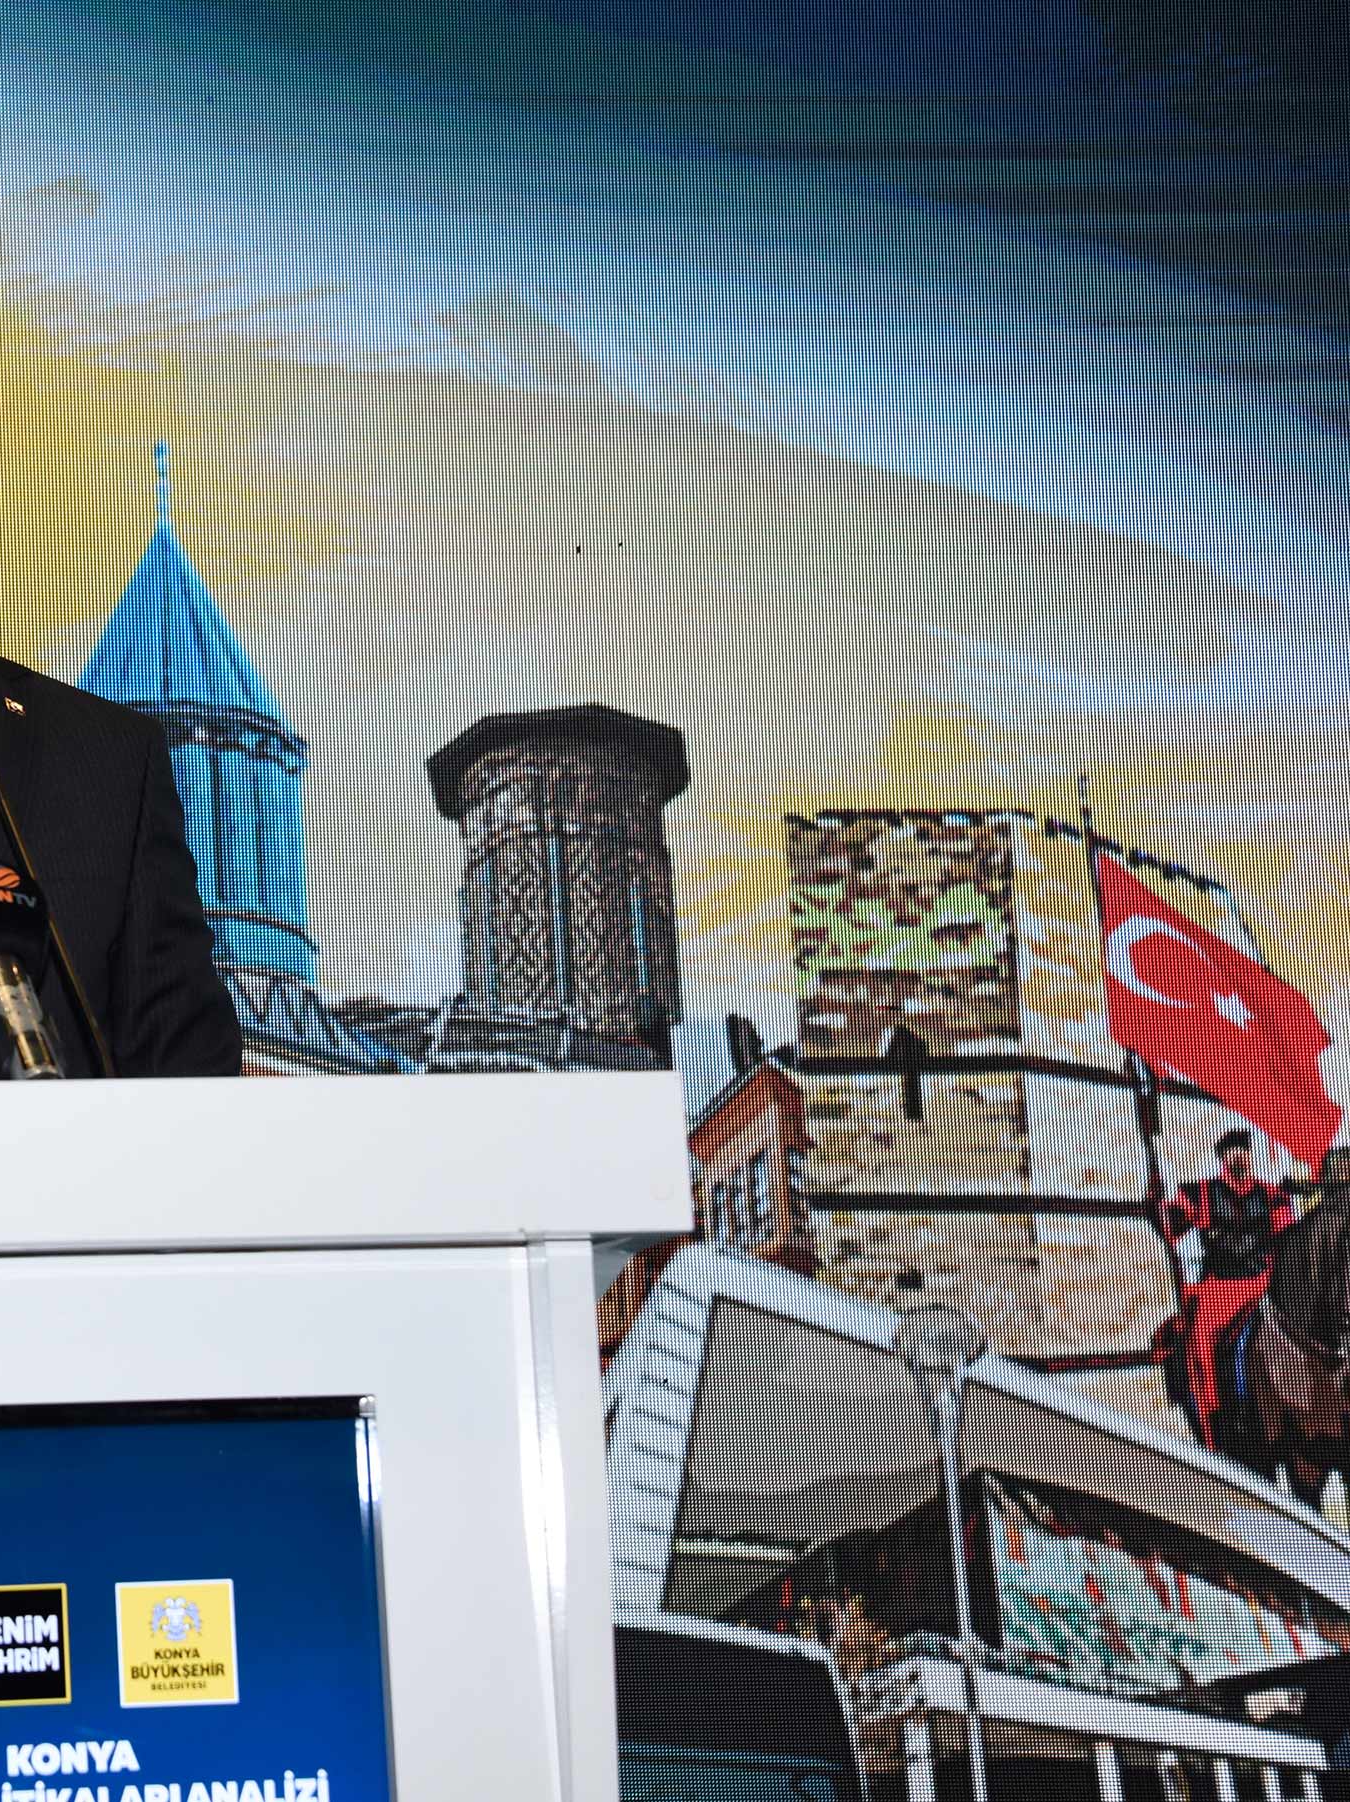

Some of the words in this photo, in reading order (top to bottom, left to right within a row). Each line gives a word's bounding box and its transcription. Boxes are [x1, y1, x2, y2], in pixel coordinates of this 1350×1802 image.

[153, 1648, 201, 1660] KONYA
[130, 1660, 226, 1680] BÜYÜKŞEHİR
[6, 1739, 141, 1777] KONYA
[185, 1768, 331, 1802] ANALİZİ
